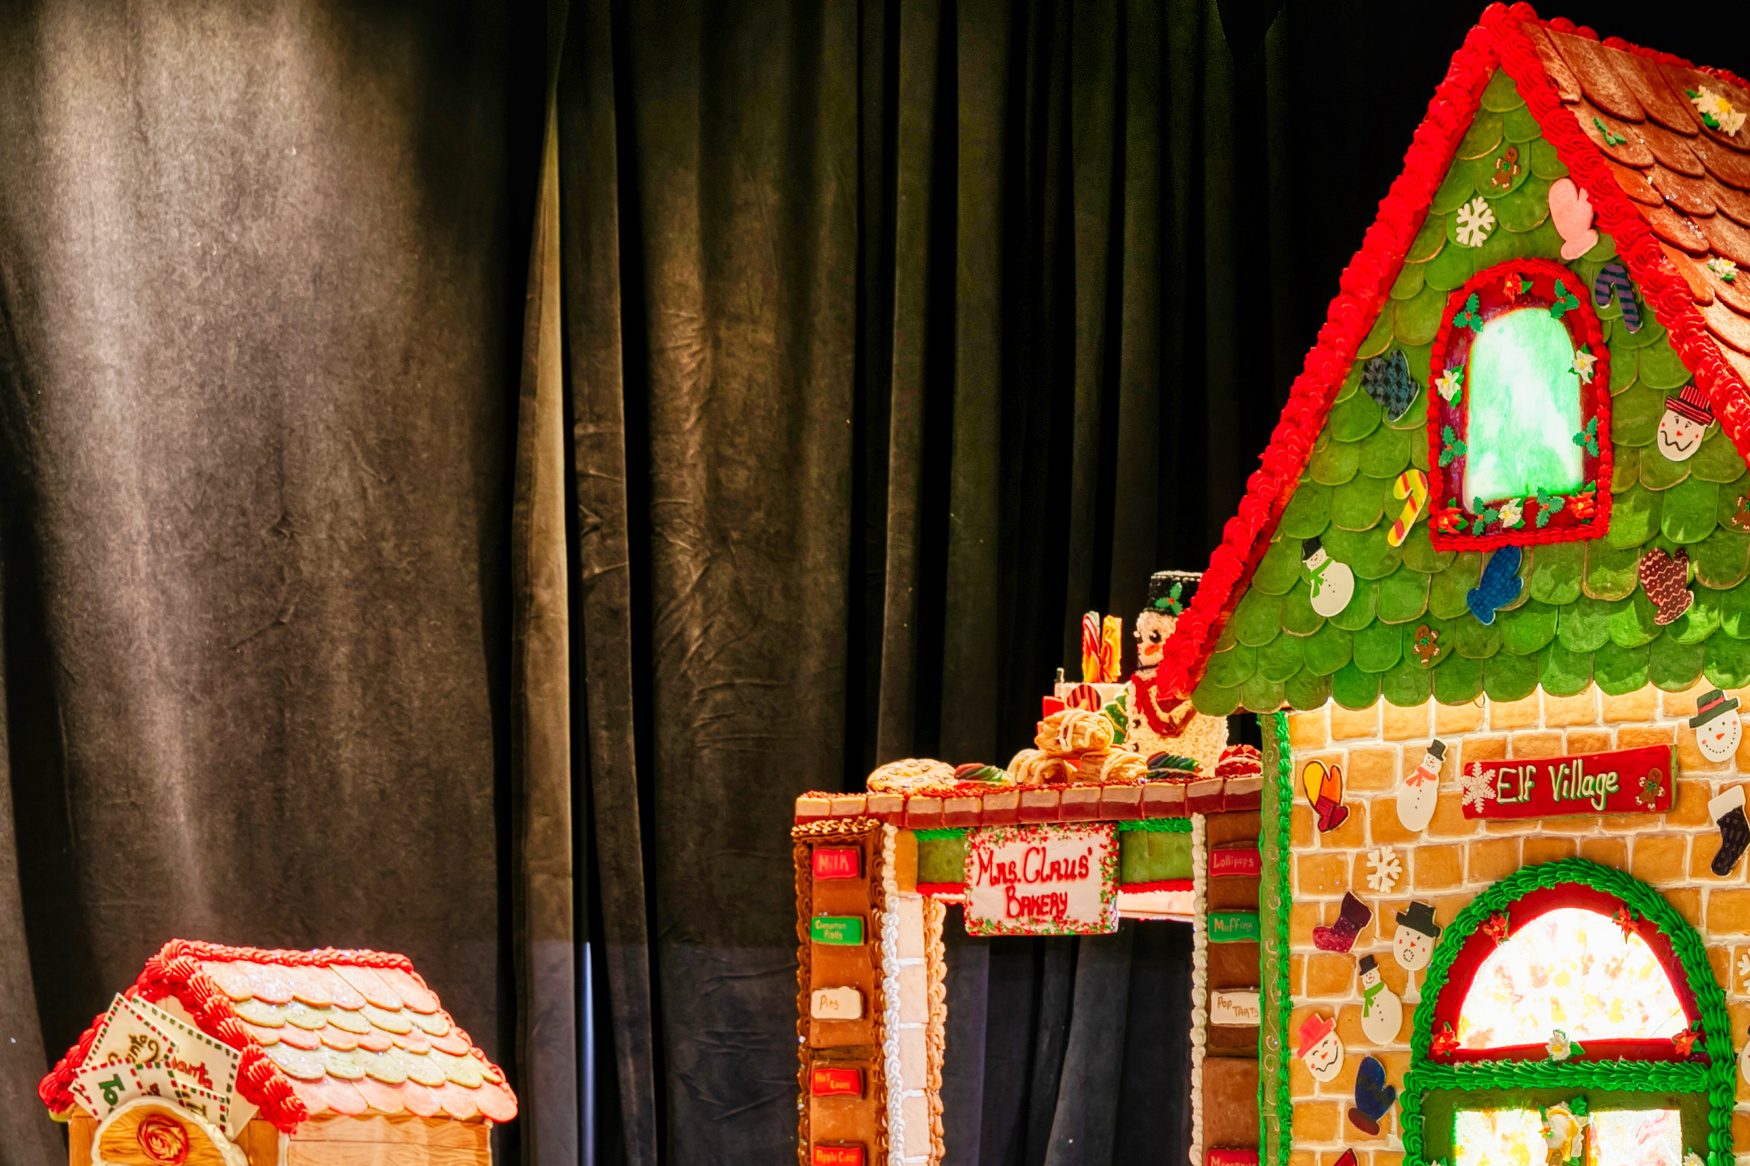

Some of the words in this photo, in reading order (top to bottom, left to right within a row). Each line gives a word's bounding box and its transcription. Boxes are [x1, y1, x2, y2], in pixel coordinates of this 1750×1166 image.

[1496, 764, 1537, 804] Elf
[1547, 758, 1621, 812] Village
[1213, 853, 1254, 870] Lollipops
